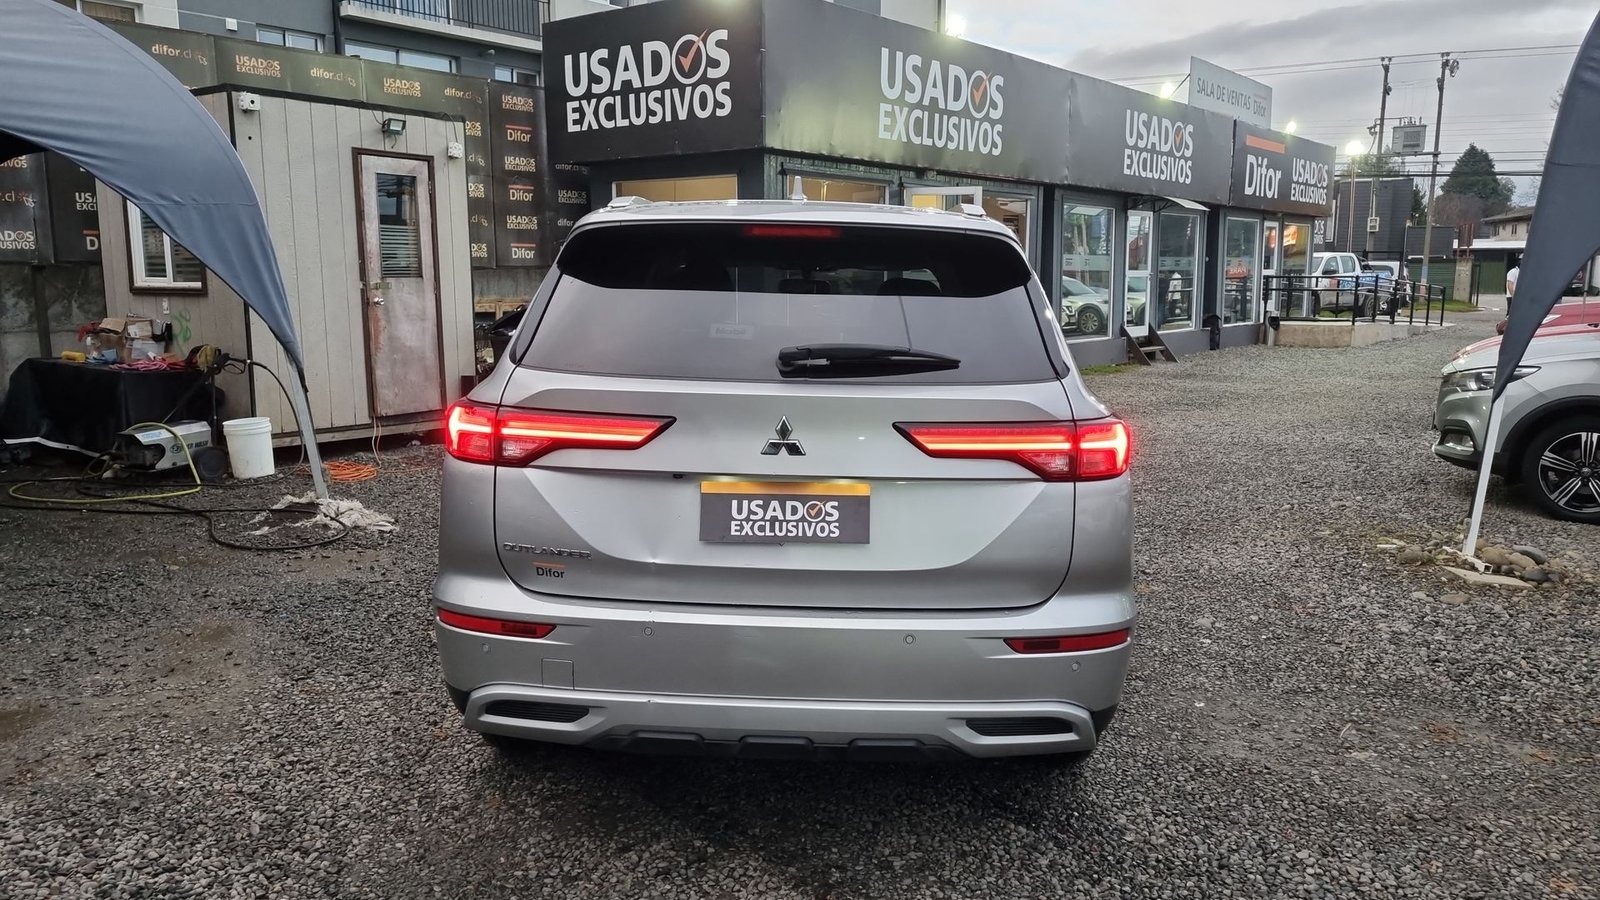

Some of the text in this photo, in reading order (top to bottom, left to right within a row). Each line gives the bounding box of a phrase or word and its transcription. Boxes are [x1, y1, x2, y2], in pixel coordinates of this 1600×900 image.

[152, 44, 191, 59] difor.cl
[235, 55, 280, 70] USADOS
[564, 29, 730, 97] USADOS
[236, 65, 281, 78] EXCLUSIVOS
[384, 77, 421, 91] USADOS
[880, 47, 1004, 120] USADOS
[384, 87, 422, 98] EXCLUSIVOS
[1196, 78, 1251, 111] SALA DE VENTAS
[502, 94, 534, 107] USADOS
[566, 81, 732, 133] EXCLUSIVOS
[502, 103, 534, 113] EXCLUSIVOS
[465, 120, 481, 131] DOS
[878, 102, 1003, 156] EXCLUSIVOS
[465, 129, 482, 137] SIVOS
[507, 129, 532, 143] Difor
[1125, 109, 1194, 158] USADOS
[504, 155, 536, 167] USADOS
[1123, 148, 1192, 185] EXCLUSIVOS
[504, 163, 536, 173] EXCLUSIVOS
[1292, 157, 1329, 187] USADOS
[1244, 154, 1281, 199] Difor
[468, 182, 484, 192] DOS
[557, 189, 587, 198] USADOS
[468, 190, 485, 198] SIVOS
[509, 189, 533, 202] Difor
[1290, 183, 1327, 206] EXCLUSIVOS
[506, 215, 538, 224] USADOS
[557, 218, 574, 227] difor
[506, 222, 538, 231] EXCLUSIVOS
[0, 241, 36, 250] USIVOS
[471, 243, 487, 252] DOS
[511, 248, 535, 259] Difor
[731, 499, 840, 522] USADOS
[730, 521, 840, 537] EXCLUSIVOS
[503, 542, 592, 560] OUTLANDER
[535, 566, 565, 578] Difor
